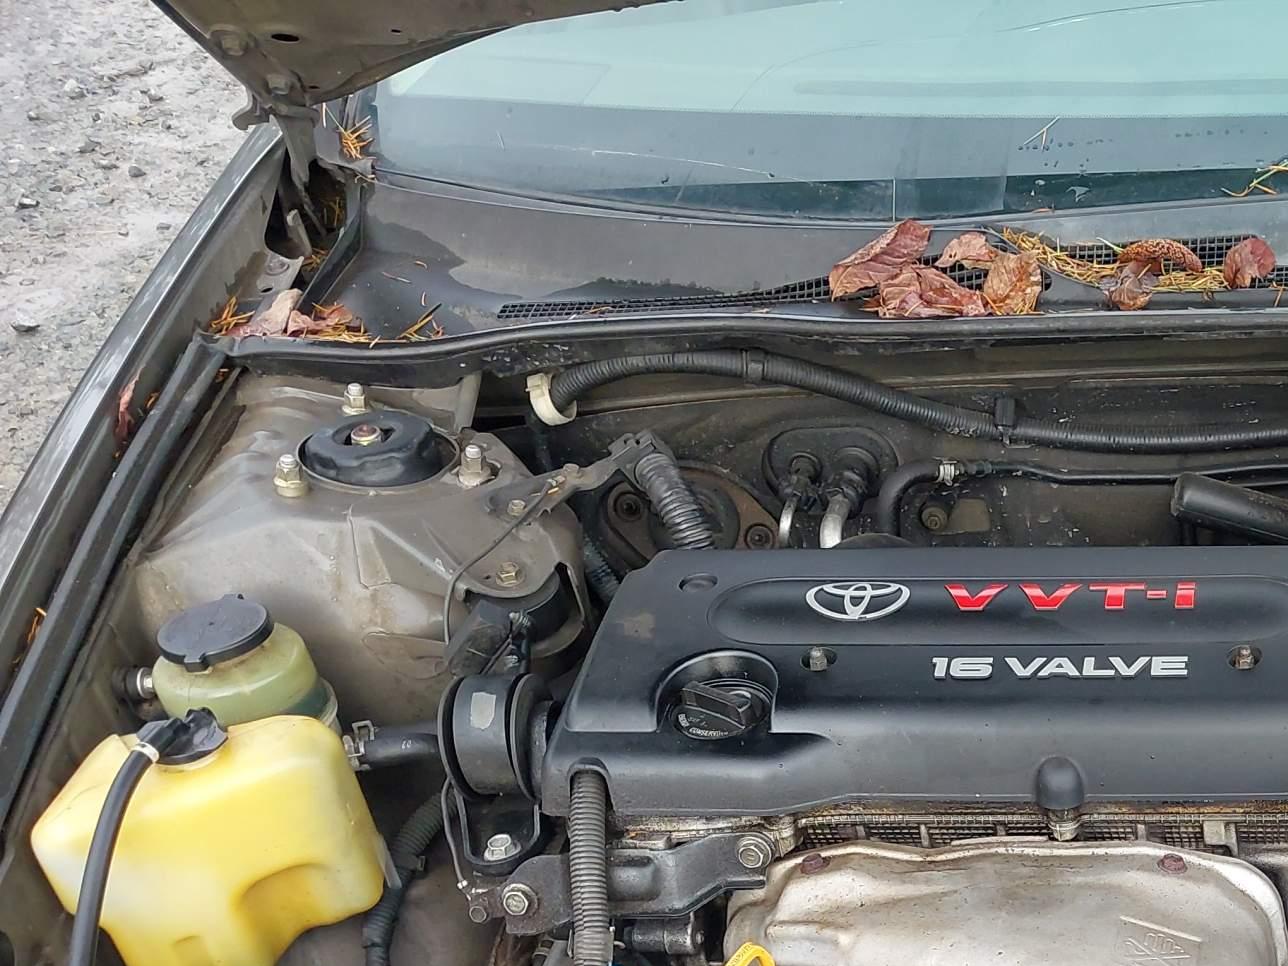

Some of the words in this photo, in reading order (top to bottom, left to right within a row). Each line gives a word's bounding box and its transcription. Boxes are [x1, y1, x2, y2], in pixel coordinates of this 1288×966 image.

[943, 581, 1196, 613] VVT-i
[931, 656, 994, 679] 16
[1004, 655, 1188, 679] VALVE
